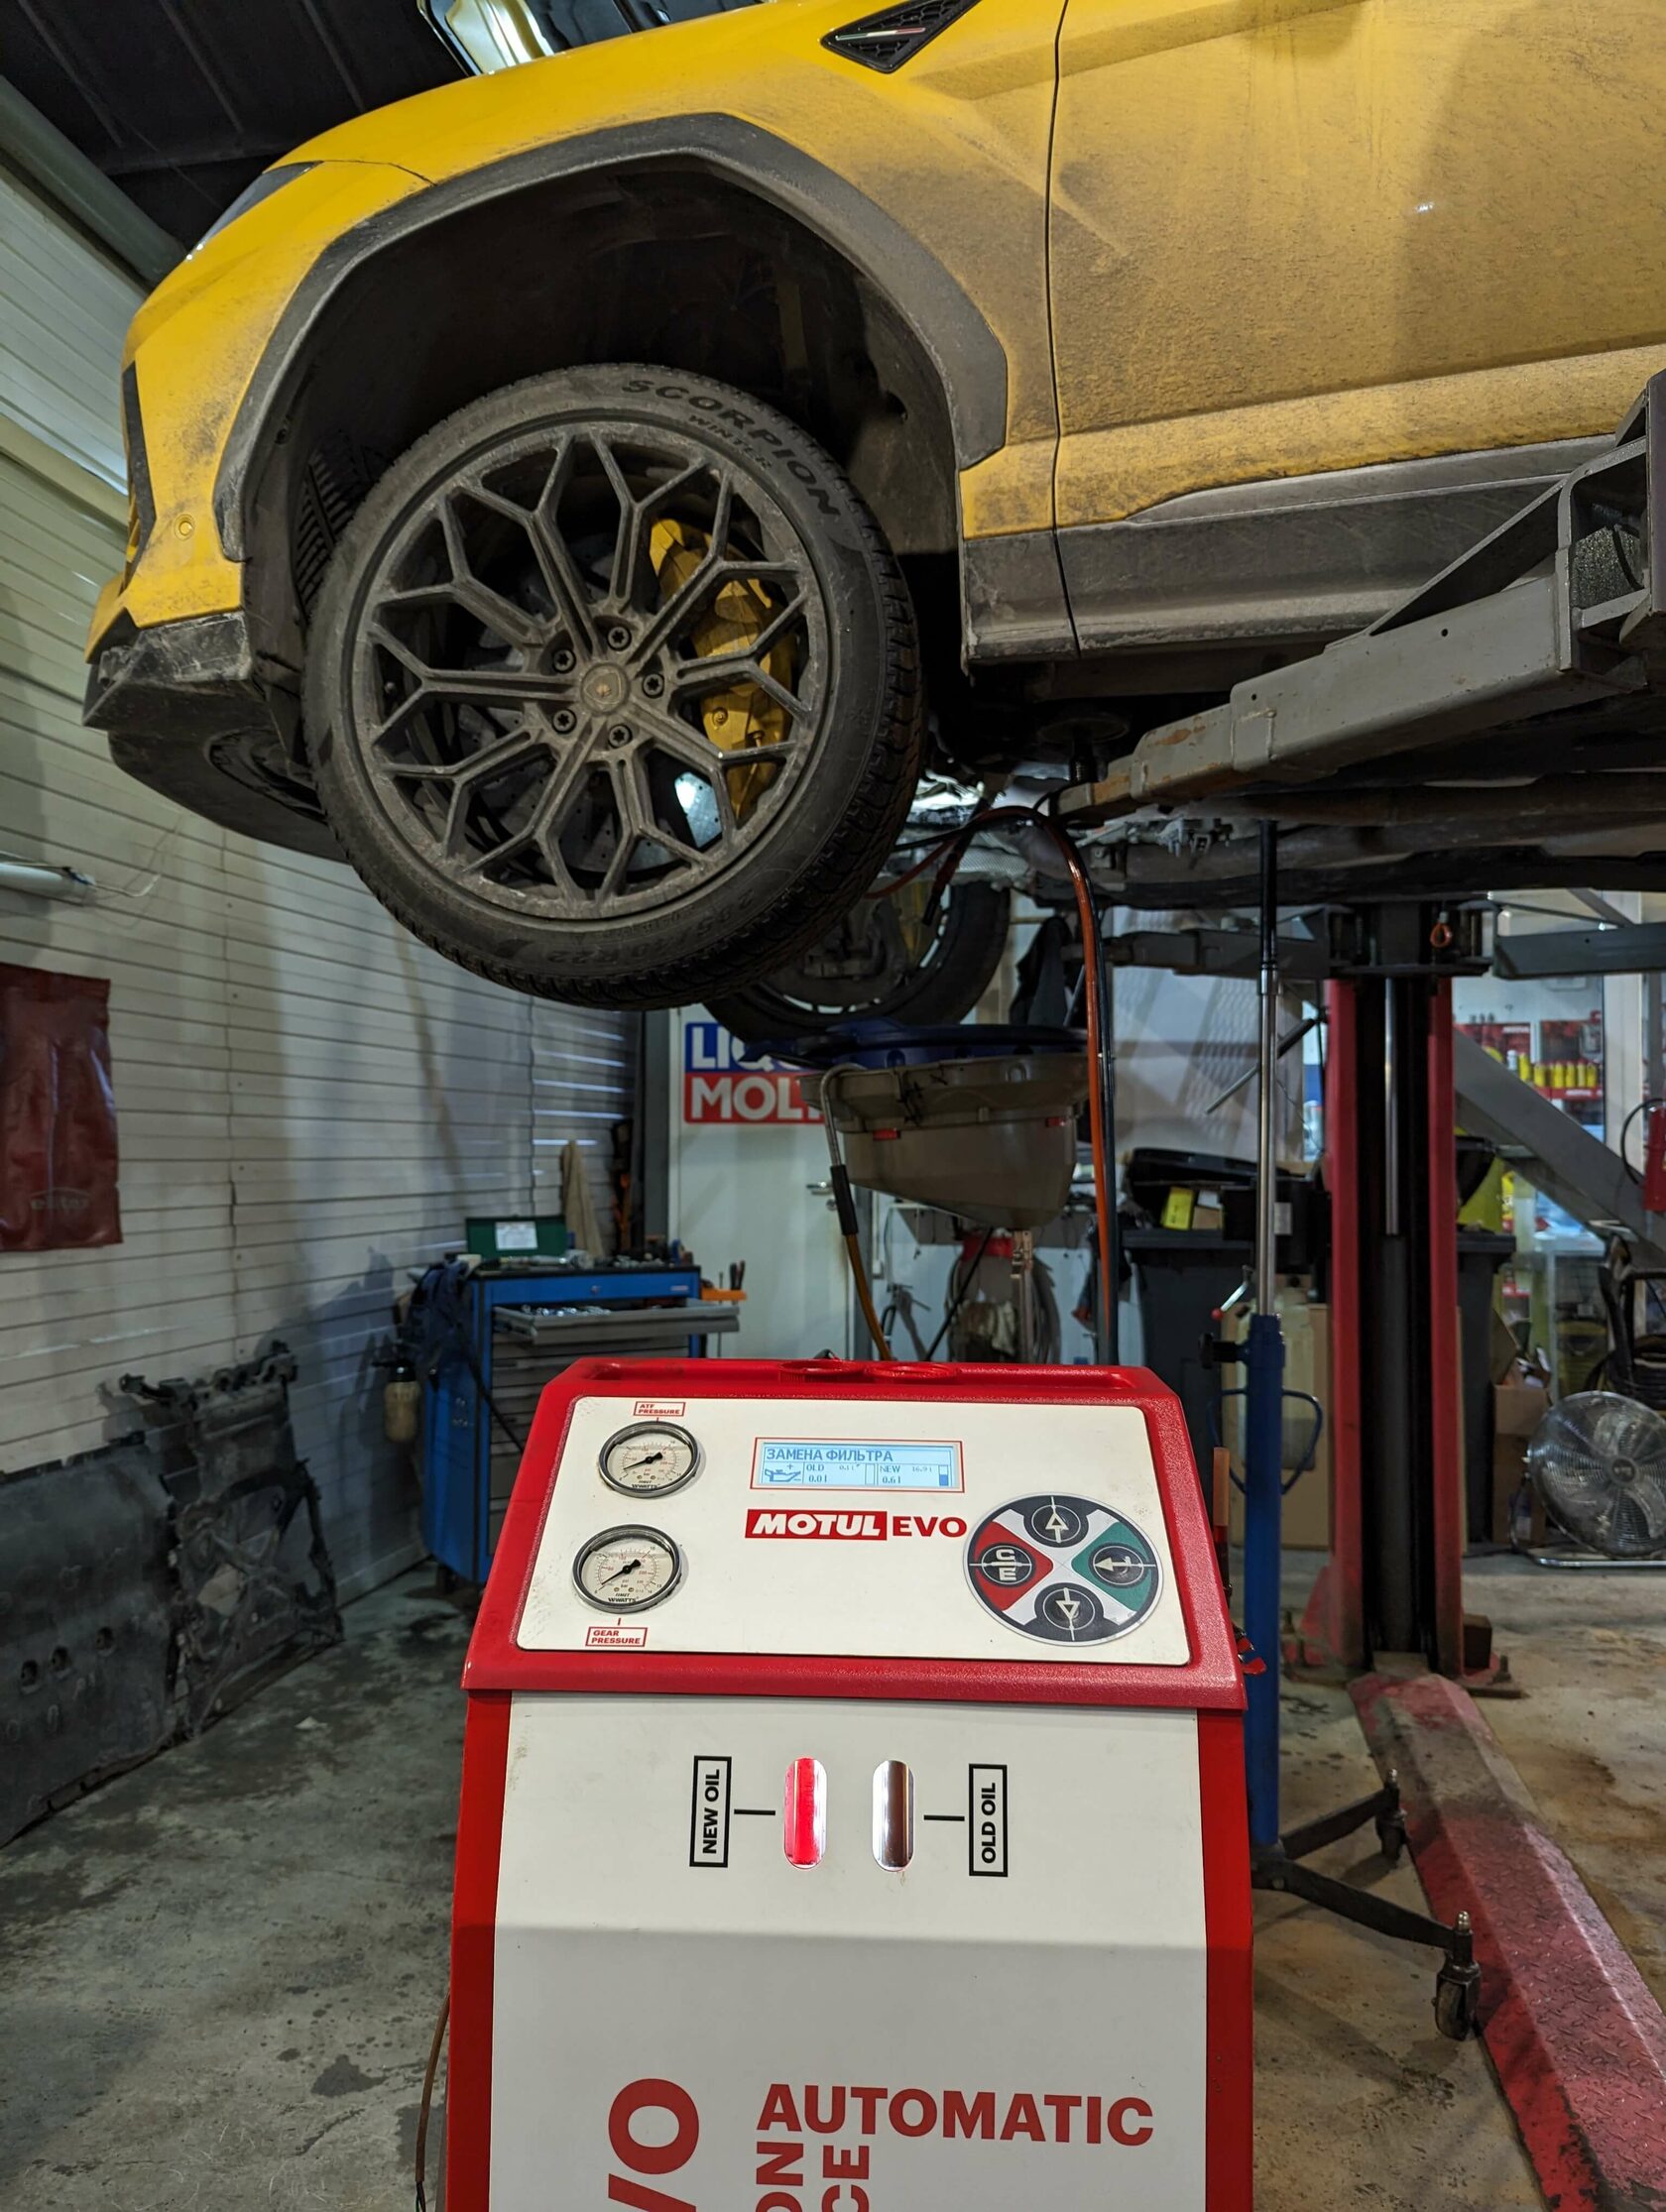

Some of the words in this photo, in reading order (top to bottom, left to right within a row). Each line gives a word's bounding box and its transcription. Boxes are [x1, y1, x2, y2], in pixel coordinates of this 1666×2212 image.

[622, 380, 841, 516] SCORPION
[689, 414, 772, 469] WINTER
[767, 1449, 822, 1460] ЗАМЕНА
[826, 1450, 892, 1461] ФИЛЬТРА
[752, 1513, 882, 1537] MOTUL
[892, 1516, 967, 1538] EVO
[704, 1769, 720, 1803] OIL
[981, 1783, 997, 1816] OIL
[702, 1807, 719, 1854] NEW
[981, 1821, 997, 1864] OLD
[756, 2083, 1154, 2147] AUTOMATIC
